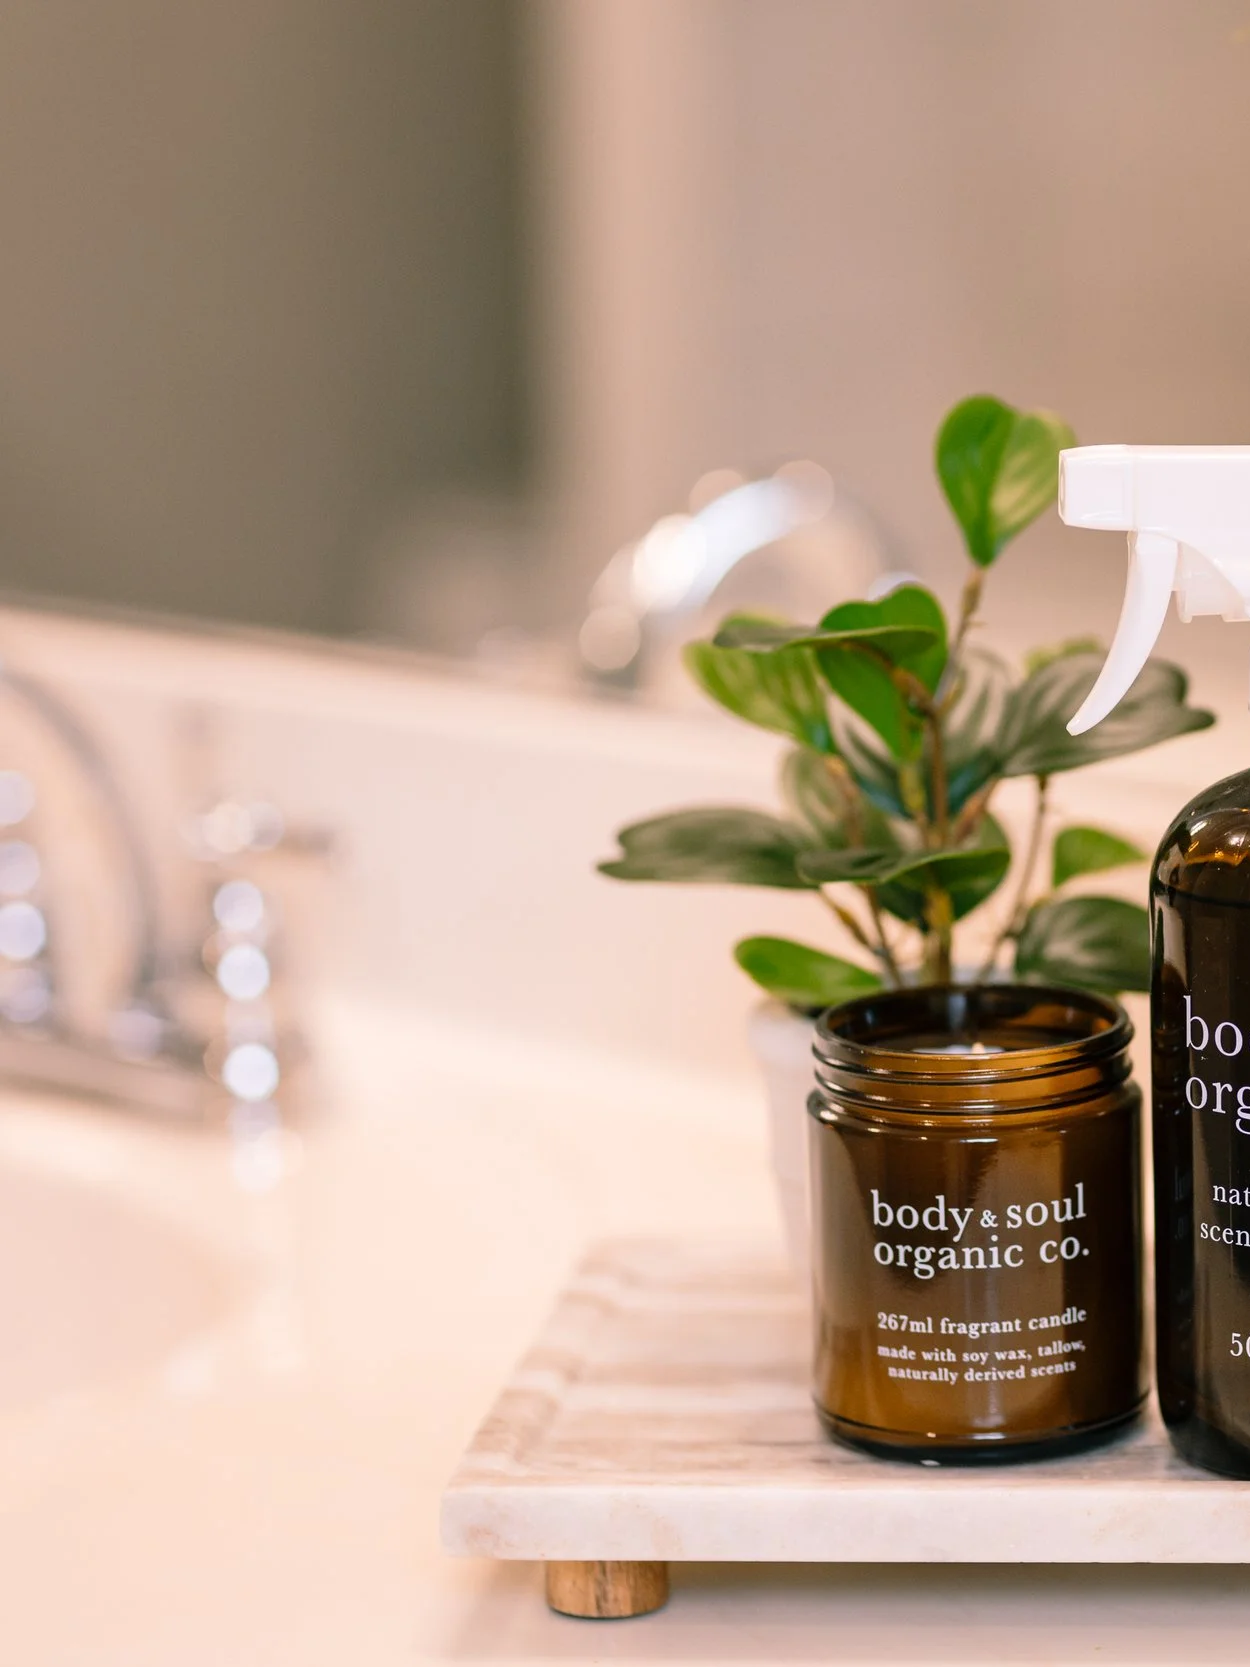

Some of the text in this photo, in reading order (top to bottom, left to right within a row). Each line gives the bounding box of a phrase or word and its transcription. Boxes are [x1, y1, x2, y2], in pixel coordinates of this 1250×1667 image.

[870, 1182, 1087, 1243] body & soul
[873, 1234, 1090, 1280] organic co.
[877, 1306, 1088, 1339] 267ml fragrant candle
[877, 1339, 1087, 1366] made with soy wax, tallow,
[887, 1360, 1077, 1386] naturally derived scents
